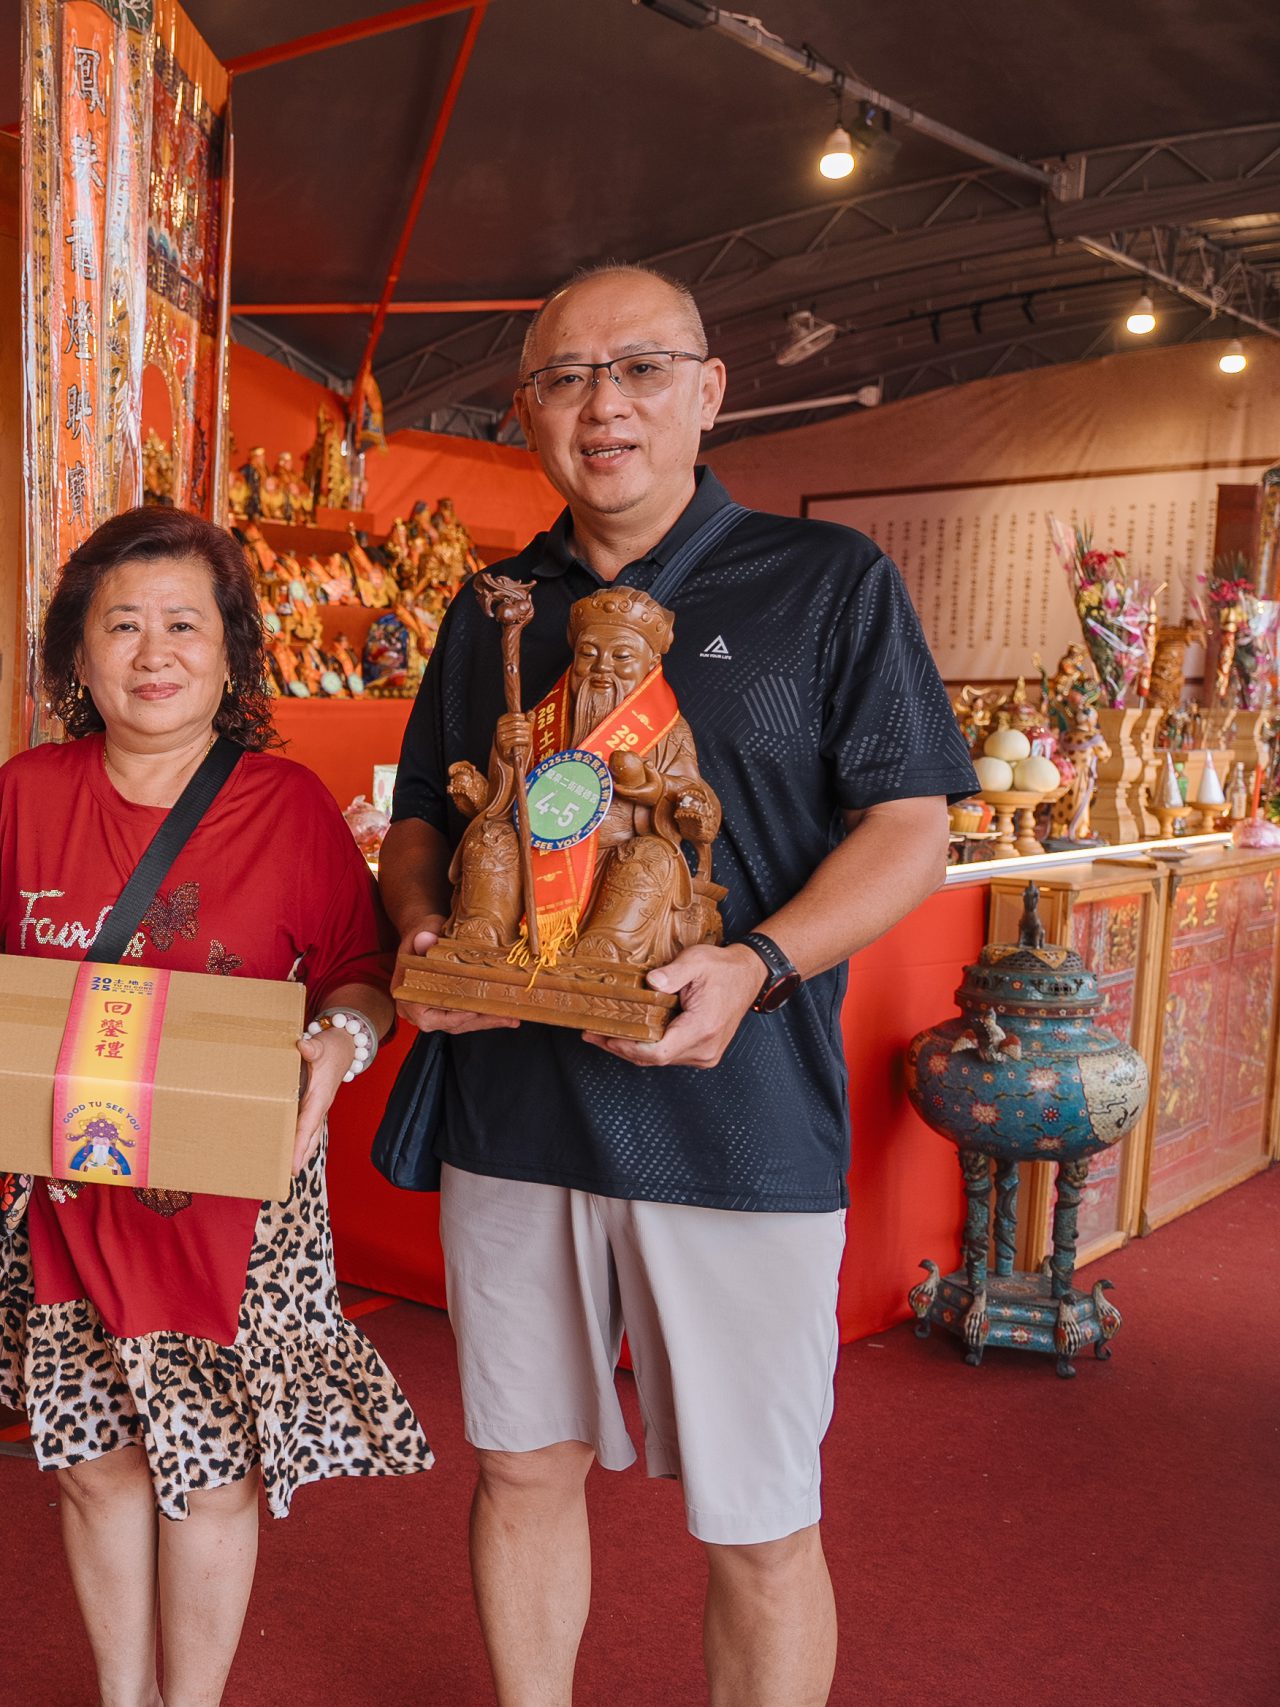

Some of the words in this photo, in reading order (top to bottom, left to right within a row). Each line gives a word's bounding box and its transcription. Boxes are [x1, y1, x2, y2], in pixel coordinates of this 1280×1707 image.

[538, 702, 556, 720] 20
[538, 714, 555, 731] 25
[616, 724, 639, 746] 20
[534, 790, 580, 828] 4-5
[534, 840, 554, 850] SEE
[556, 830, 583, 849] YOU
[91, 983, 111, 991] 25
[63, 1104, 86, 1124] GOOD
[105, 1102, 125, 1114] SEE
[126, 1113, 141, 1131] YOU
